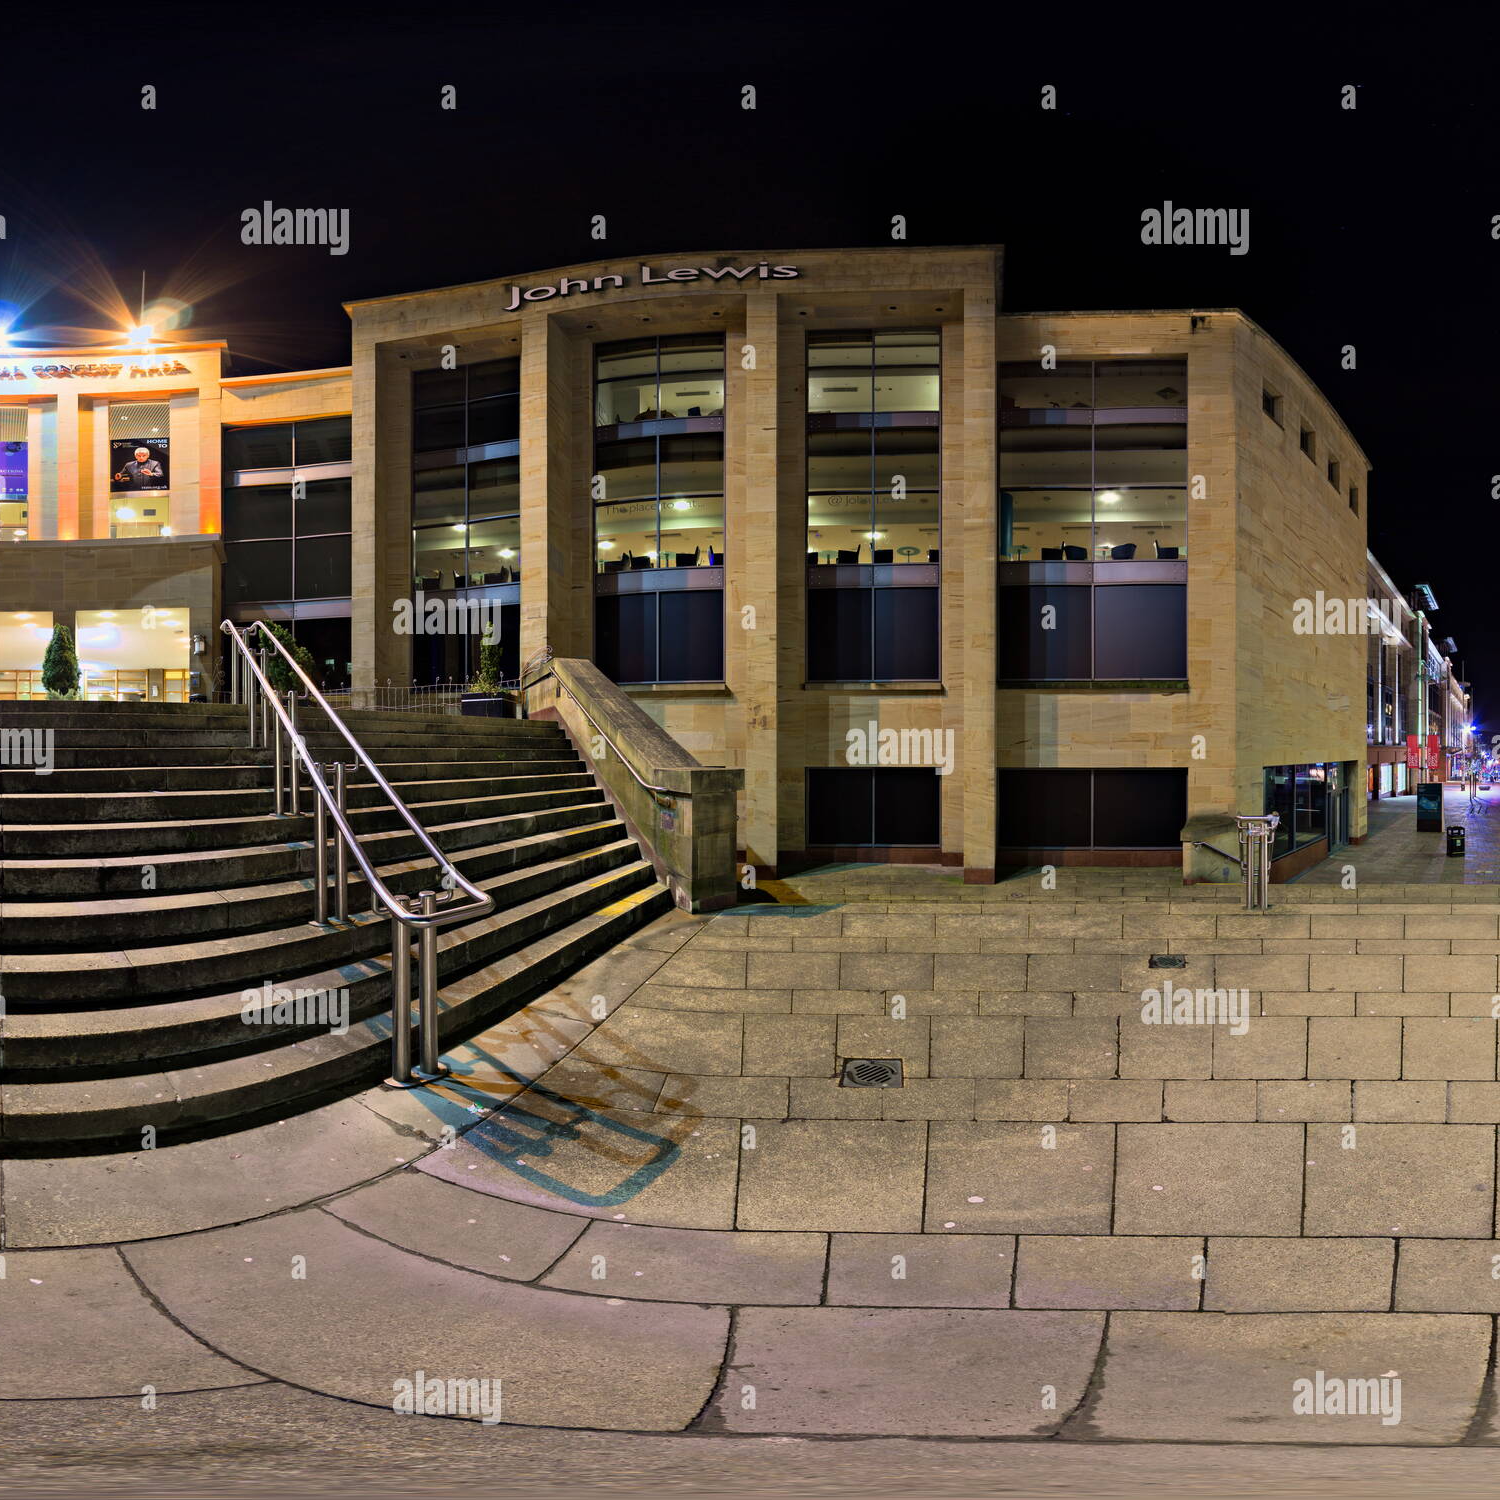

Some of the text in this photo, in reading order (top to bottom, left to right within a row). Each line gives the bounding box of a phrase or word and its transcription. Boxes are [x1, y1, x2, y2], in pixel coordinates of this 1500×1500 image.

[504, 261, 799, 311] John Lewis
[32, 363, 125, 379] CONCERT
[828, 495, 843, 507] @
[604, 504, 628, 515] The
[628, 502, 657, 514] place
